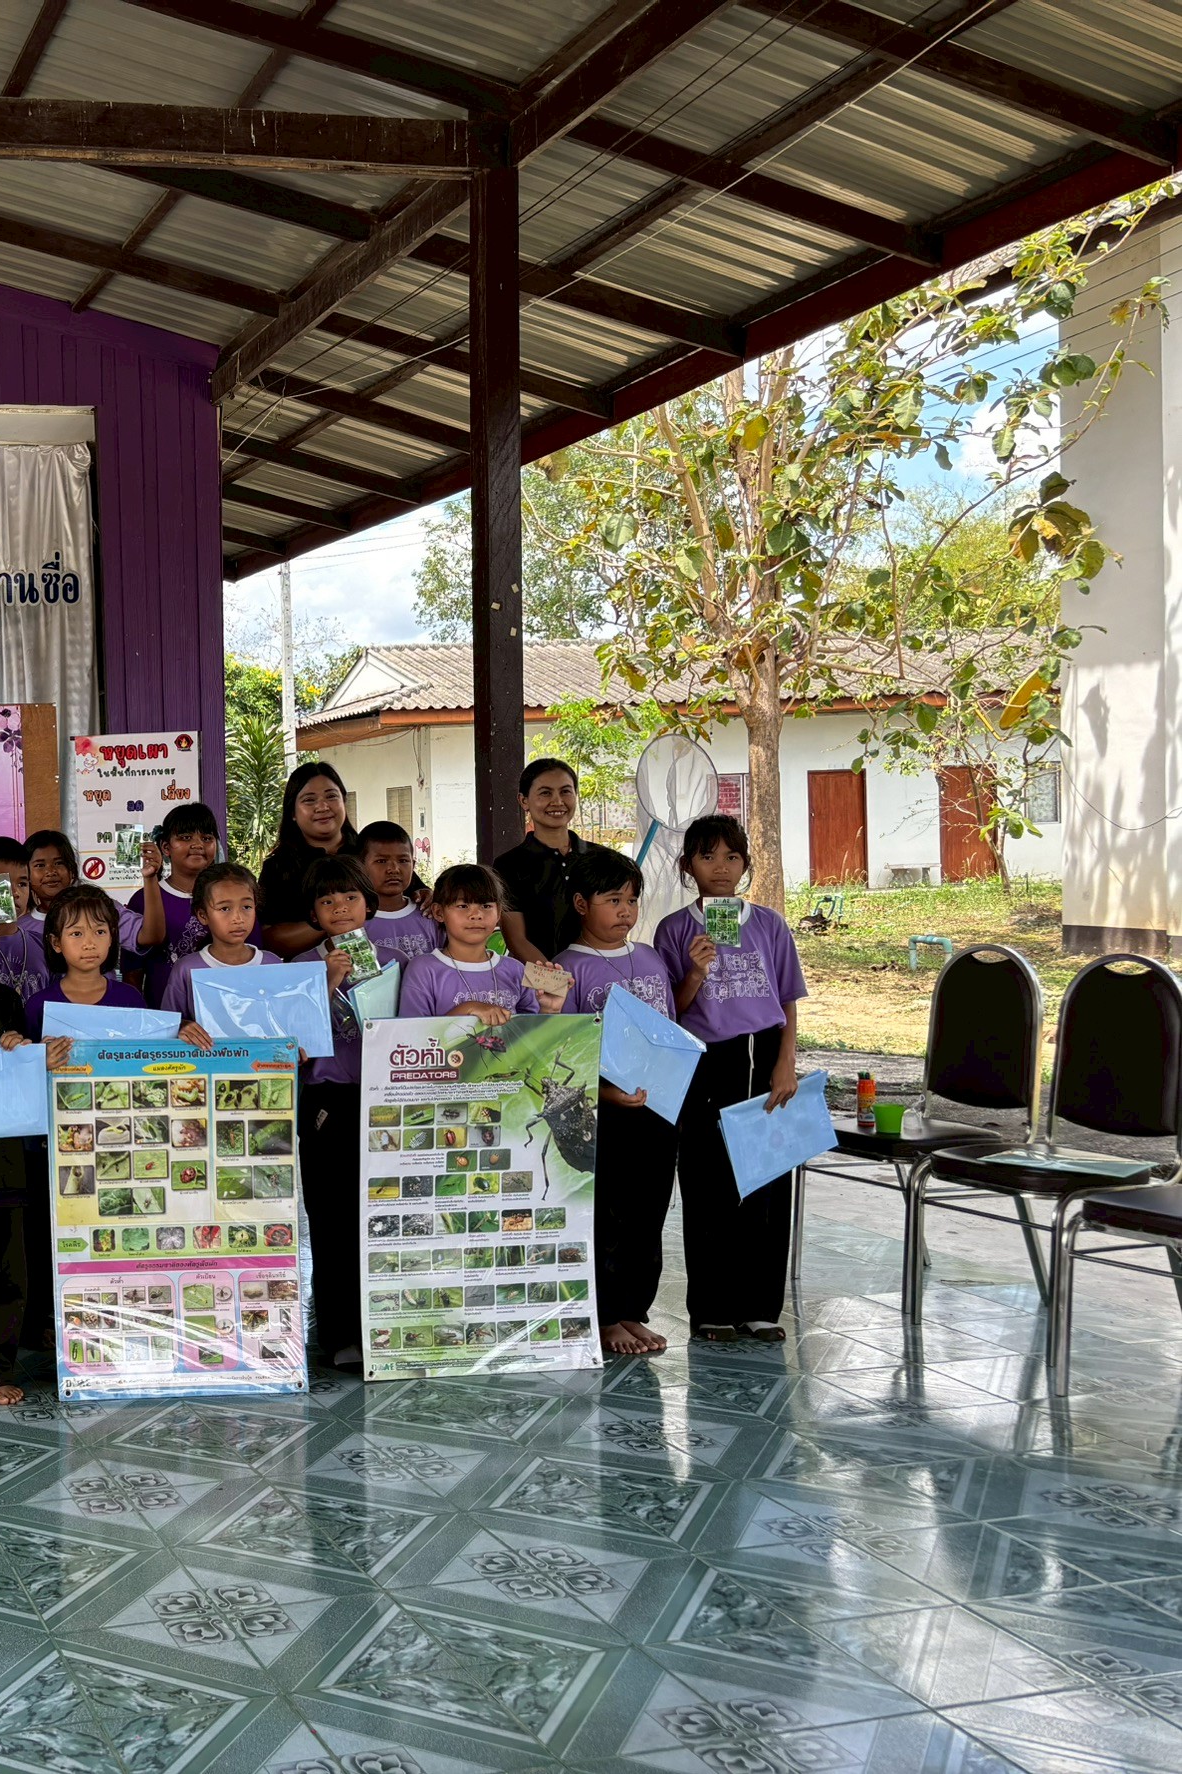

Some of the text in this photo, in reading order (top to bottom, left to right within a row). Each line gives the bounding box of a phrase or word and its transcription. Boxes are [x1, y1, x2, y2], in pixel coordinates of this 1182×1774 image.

[99, 742, 169, 768] หยุดเผา
[83, 789, 112, 807] หยุด
[389, 1037, 446, 1068] ตัวห้ำ
[391, 1070, 458, 1081] PREDATORS
